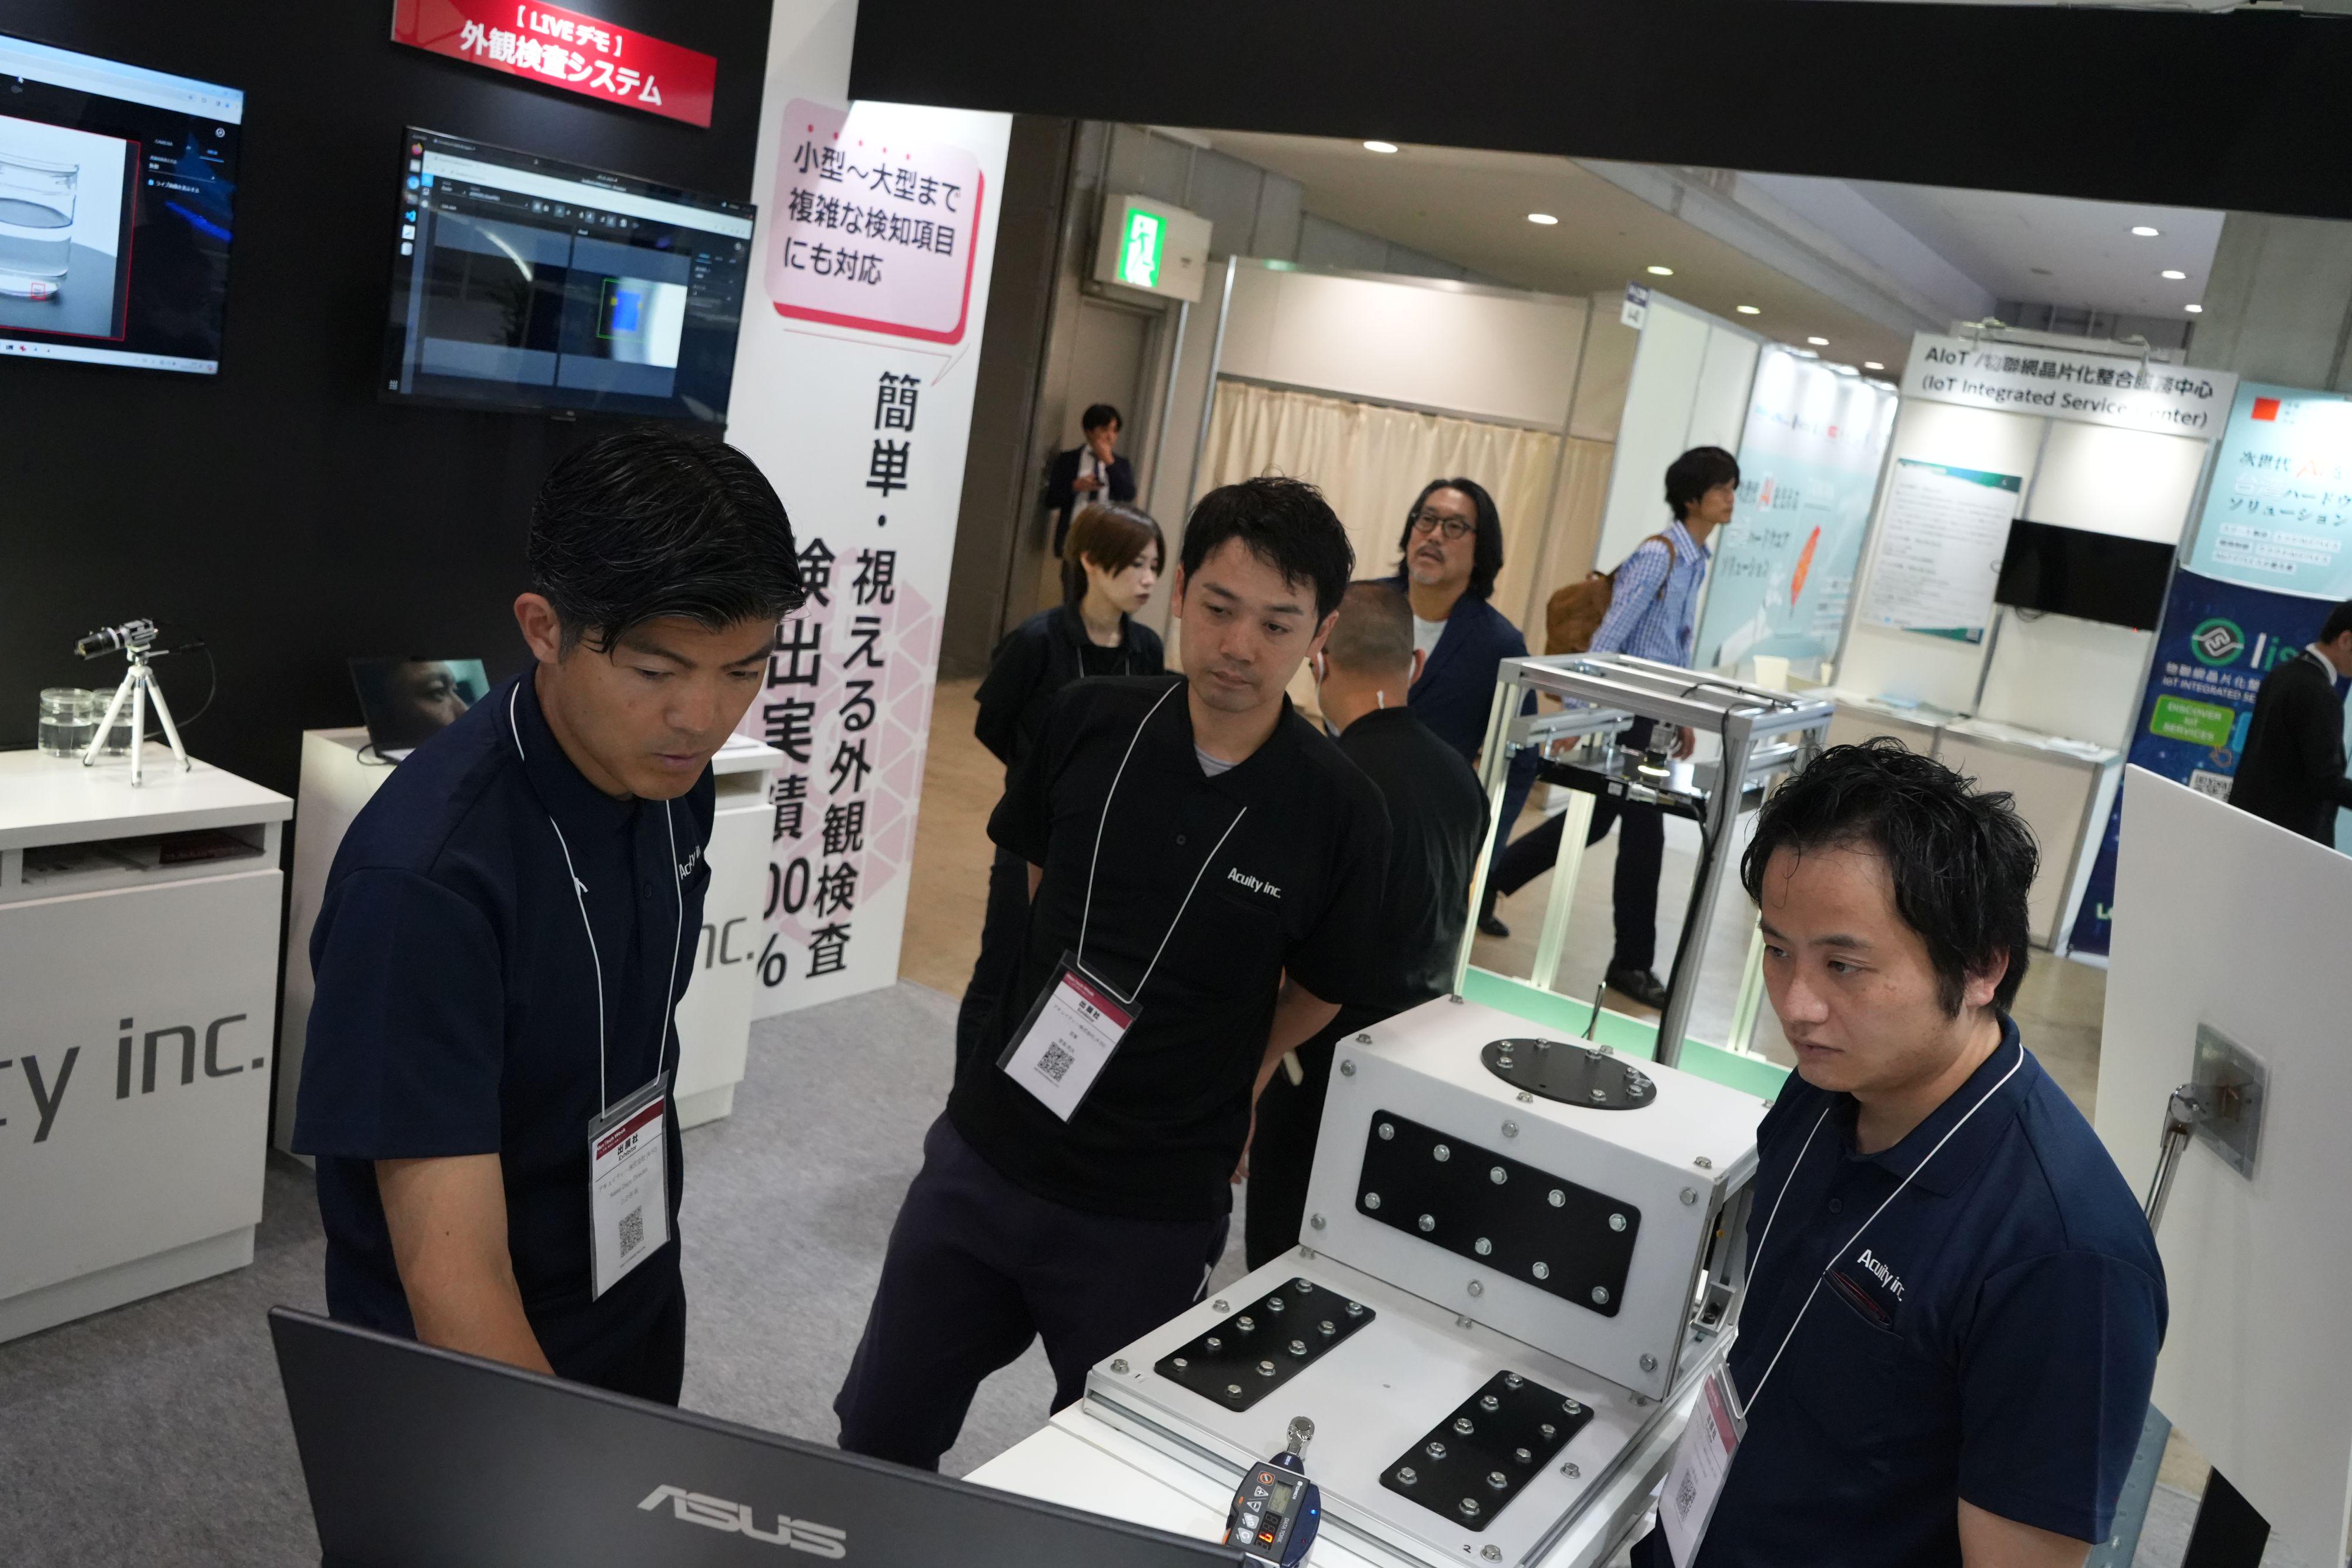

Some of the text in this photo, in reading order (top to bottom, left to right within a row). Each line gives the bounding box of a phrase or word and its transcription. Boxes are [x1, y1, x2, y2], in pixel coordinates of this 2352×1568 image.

[460, 19, 662, 106] 外観検査システム
[788, 187, 956, 256] 複雑な検知項目
[784, 237, 884, 286] にも対応
[1962, 379, 2056, 406] Integrated
[1227, 867, 1264, 893] Acuity
[116, 1012, 265, 1099] inc.
[1857, 1249, 1893, 1288] Acuity
[637, 1483, 847, 1560] ASUS
[1463, 1544, 1471, 1553] 2
